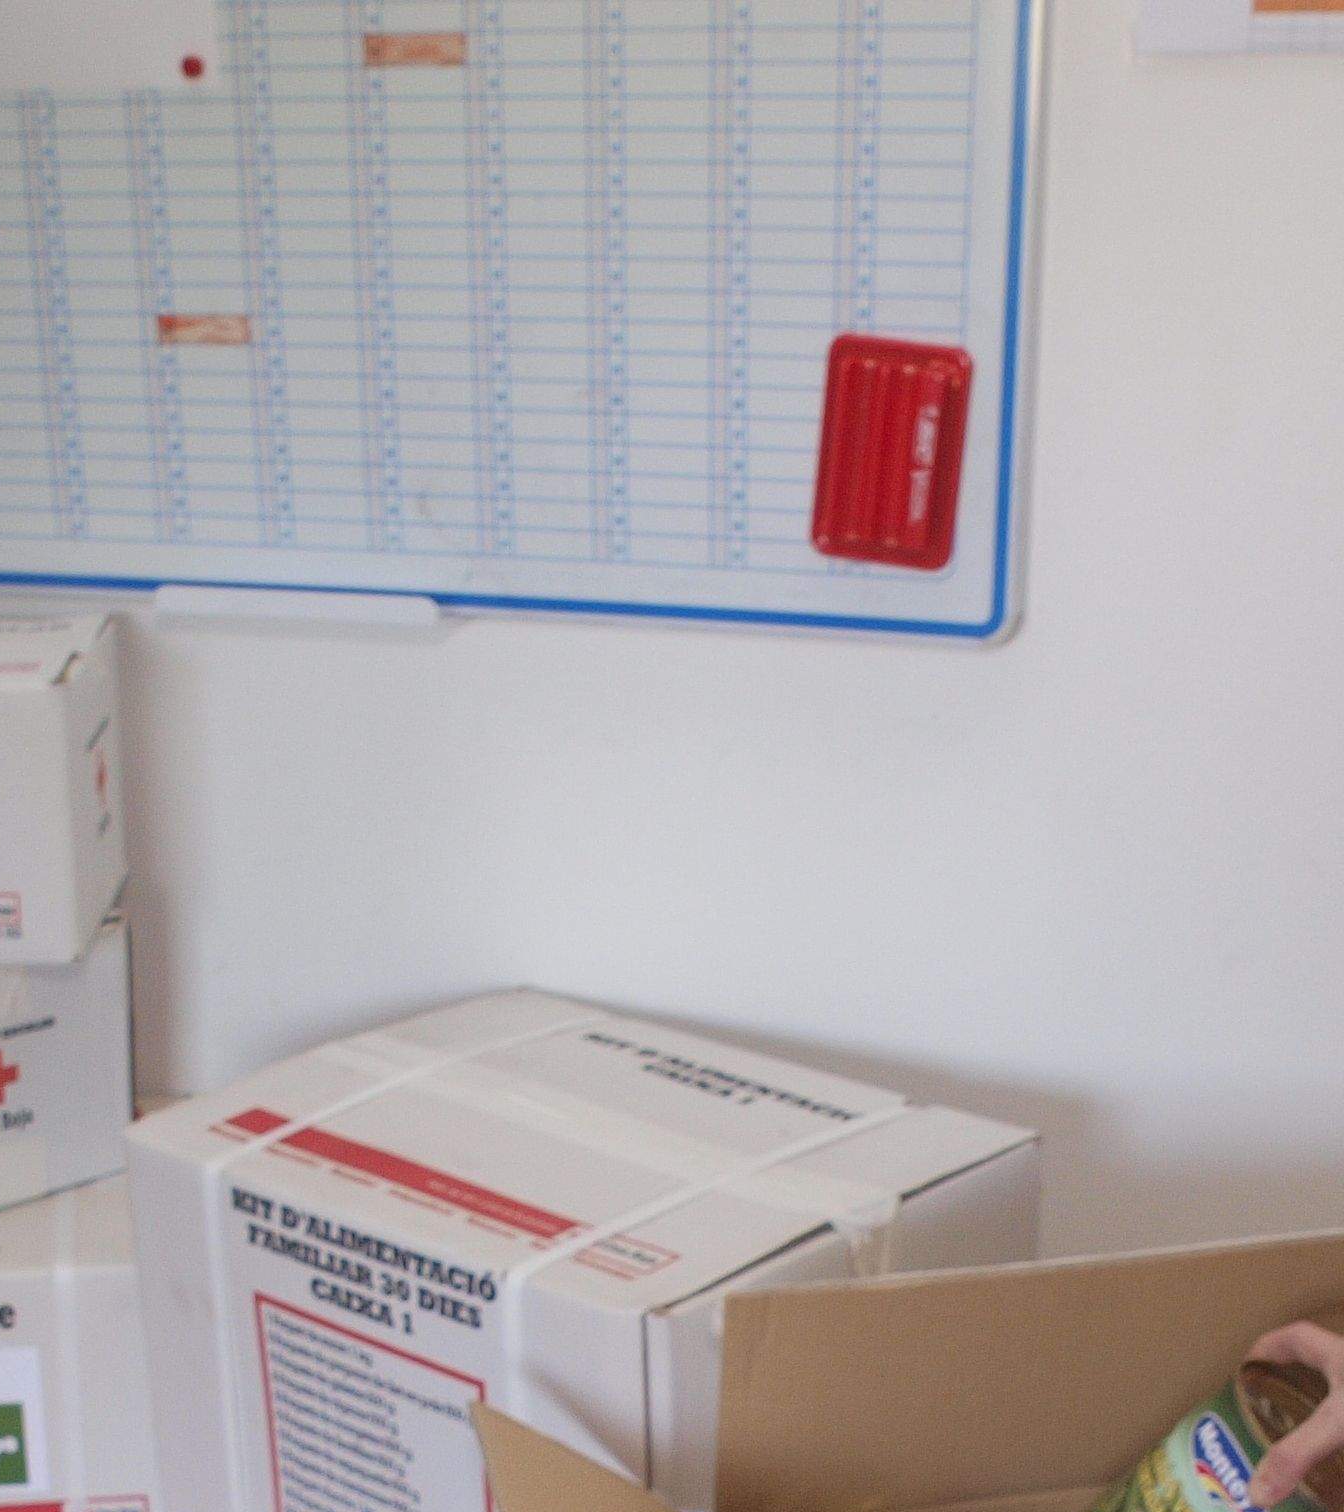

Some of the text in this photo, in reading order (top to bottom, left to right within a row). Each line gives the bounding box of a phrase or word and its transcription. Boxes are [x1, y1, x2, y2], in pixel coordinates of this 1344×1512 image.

[232, 1186, 274, 1220] KIT
[280, 1204, 497, 1302] D'ALIMENTACIÓ
[248, 1222, 374, 1291] FAMILIAR
[418, 1286, 482, 1329] DIES
[310, 1276, 395, 1328] CAIXA
[1197, 1418, 1255, 1510] Monte
